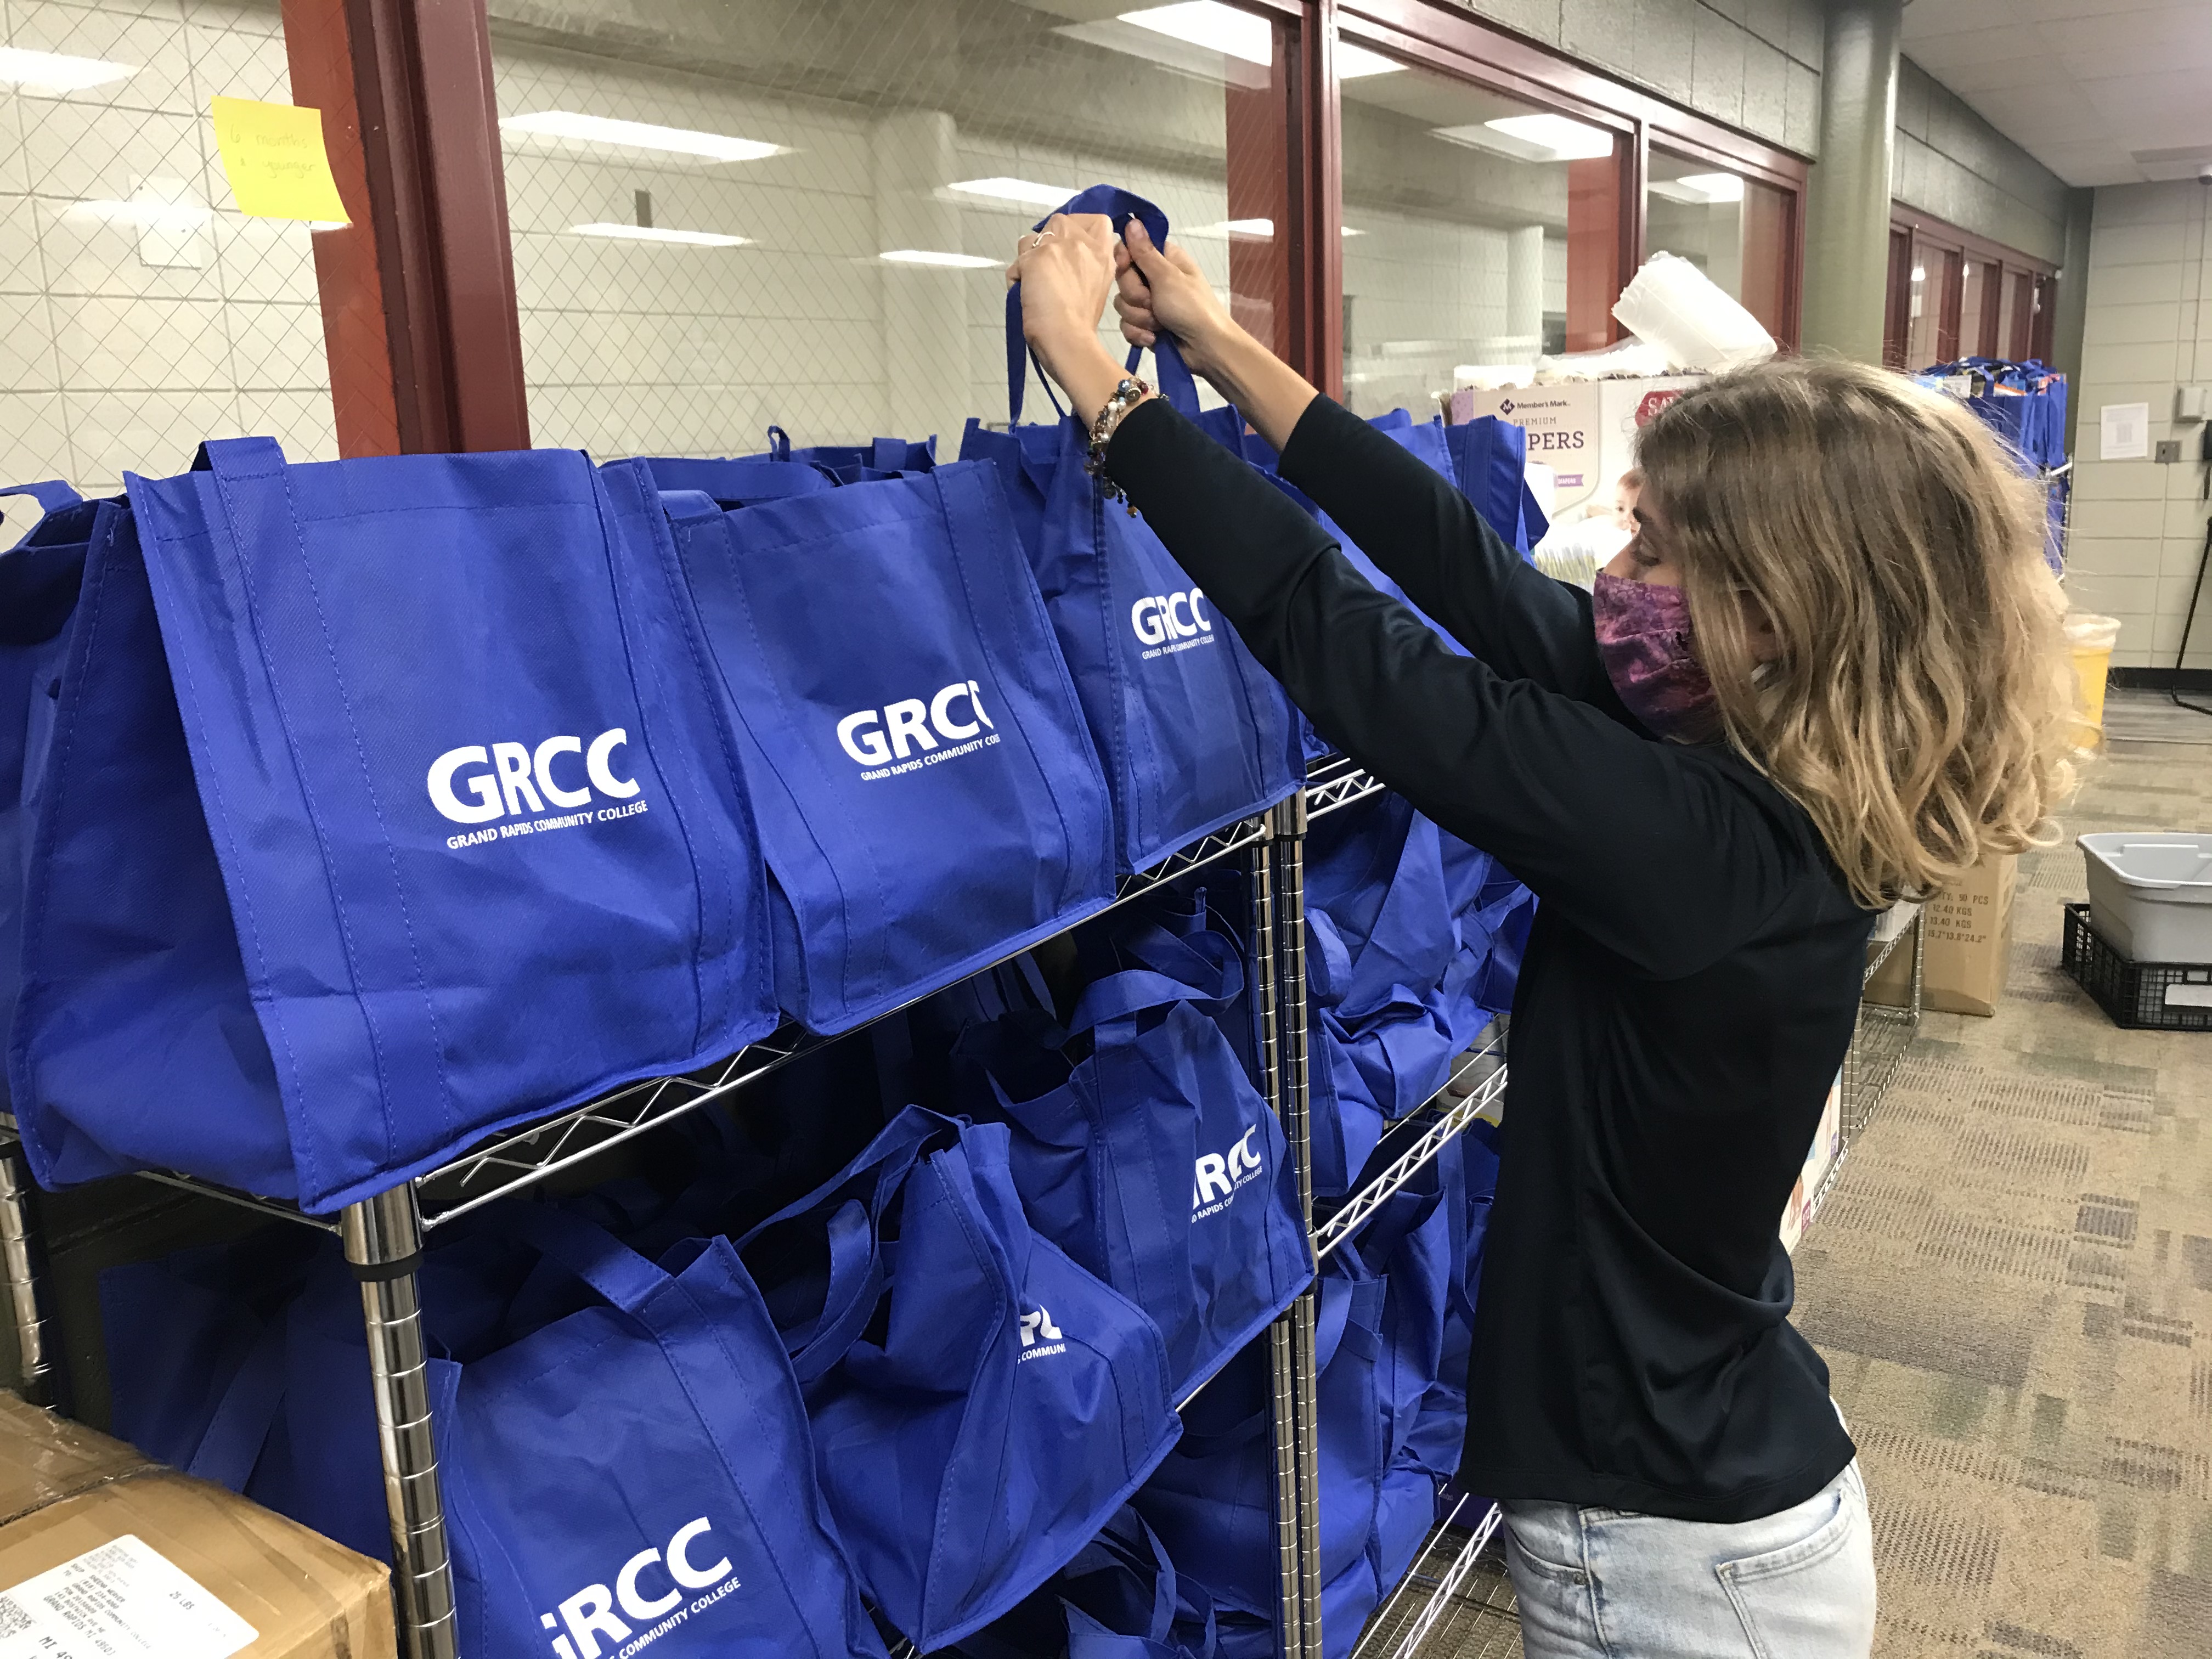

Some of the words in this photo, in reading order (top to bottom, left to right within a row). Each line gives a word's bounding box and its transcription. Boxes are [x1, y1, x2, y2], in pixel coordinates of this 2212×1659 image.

[256, 133, 307, 148] months
[262, 161, 316, 179] younger
[1517, 401, 1549, 409] Member's
[1513, 417, 1556, 426] PREMIUM
[1527, 430, 1584, 450] PERS
[1131, 588, 1211, 645] GRCC
[1142, 648, 1162, 659] GRAND
[860, 768, 891, 781] GRAND
[890, 759, 923, 775] RAPIDS
[924, 739, 983, 766] COMMUNITY
[427, 728, 641, 823] GRCC
[447, 828, 498, 849] GRAND
[499, 822, 533, 838] RAPIDS
[533, 811, 594, 832] COMMUNITY
[597, 800, 648, 822] COLLEGE
[1973, 895, 1989, 905] PCS
[1956, 906, 1972, 916] KGS
[1956, 919, 1972, 928] KGS
[1197, 1202, 1224, 1220] RAPIDS
[1243, 1166, 1262, 1184] COLLEGE
[540, 1516, 733, 1659] RCC
[179, 1598, 195, 1610] LBS
[43, 1595, 65, 1611] GRAND
[62, 1611, 87, 1630] RAPIDS
[84, 1629, 97, 1638] MI
[619, 1608, 689, 1659] COMMUNITY
[691, 1577, 741, 1613] COLLEGE
[38, 1636, 58, 1649] MI
